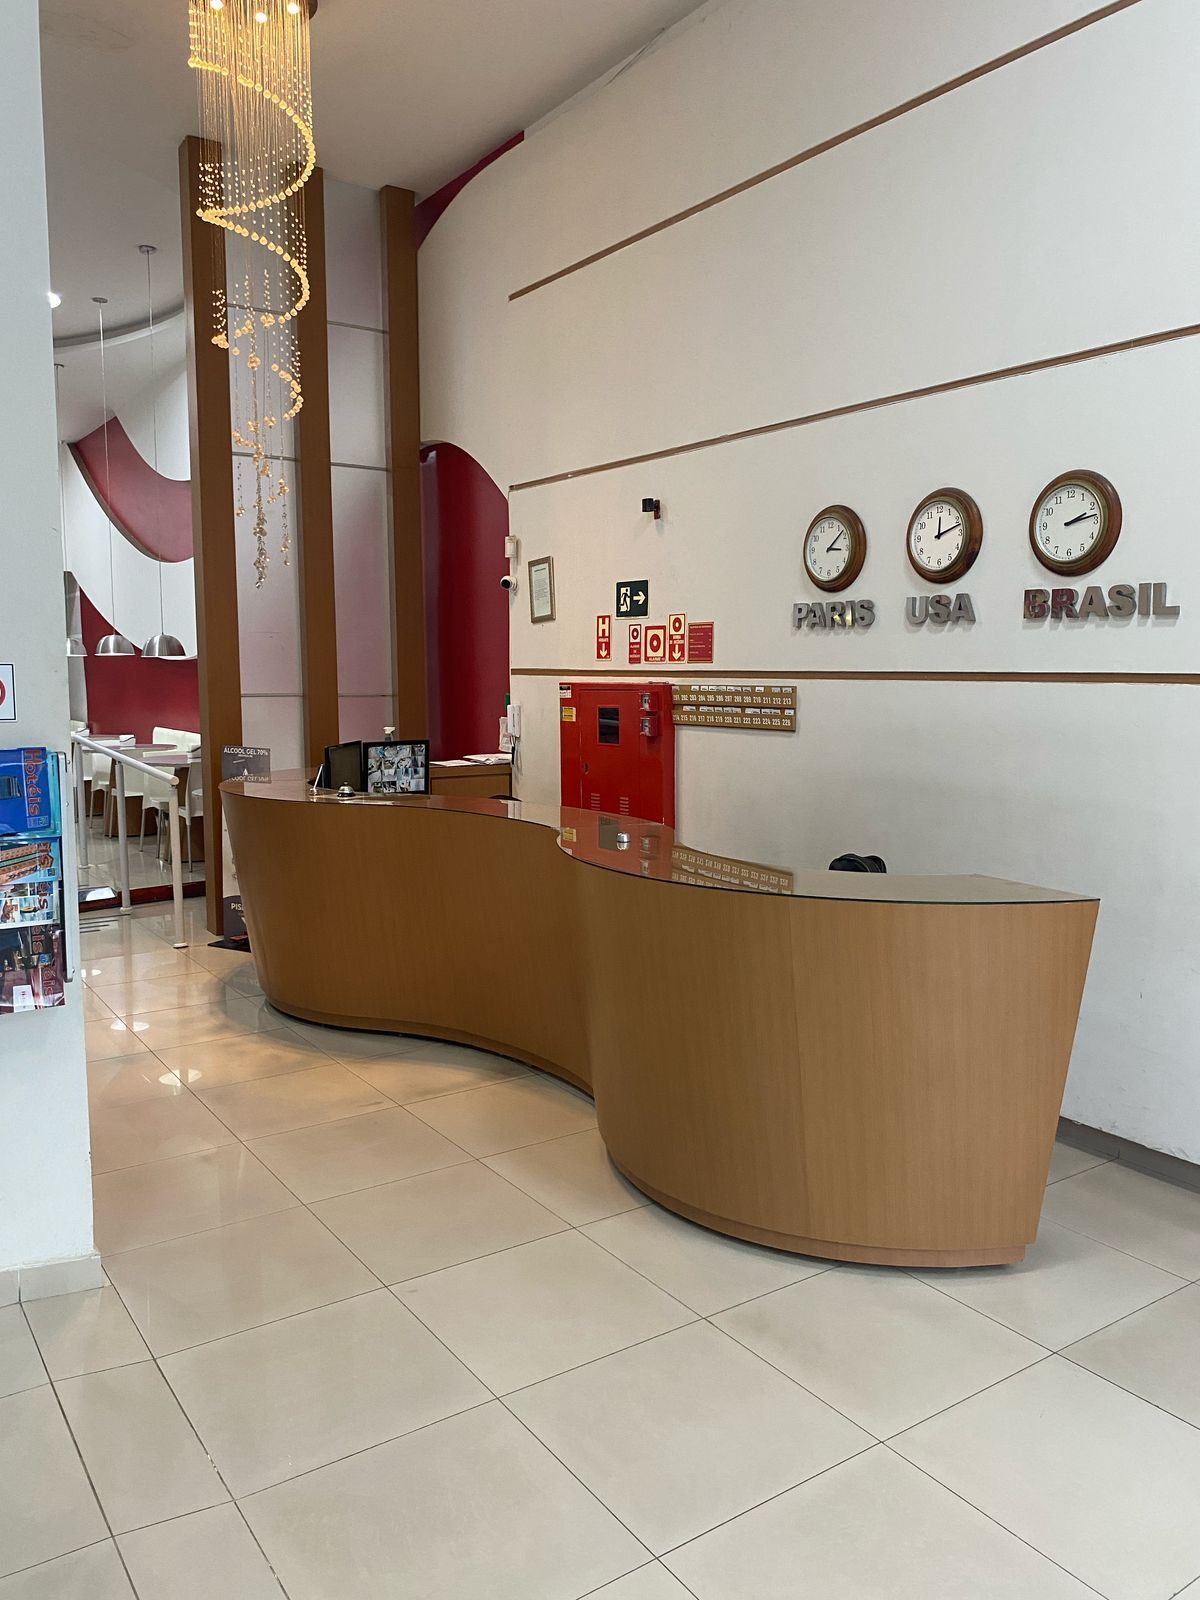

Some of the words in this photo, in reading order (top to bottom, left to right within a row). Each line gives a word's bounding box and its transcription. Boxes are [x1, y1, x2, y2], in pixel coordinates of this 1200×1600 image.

[1067, 490, 1075, 498] 12
[1082, 493, 1084, 501] 1
[1055, 496, 1061, 504] 11
[1090, 502, 1095, 510] 2
[1046, 507, 1053, 516] 10
[1094, 516, 1098, 524] 3
[1043, 522, 1047, 530] 9
[1045, 536, 1050, 544] 8
[1055, 546, 1059, 554] 7
[1080, 543, 1085, 552] 5
[1024, 582, 1180, 619] BRASIL
[906, 593, 976, 626] USA
[793, 600, 875, 630] PARIS
[599, 618, 609, 636] H
[25, 750, 42, 816] Hotéis
